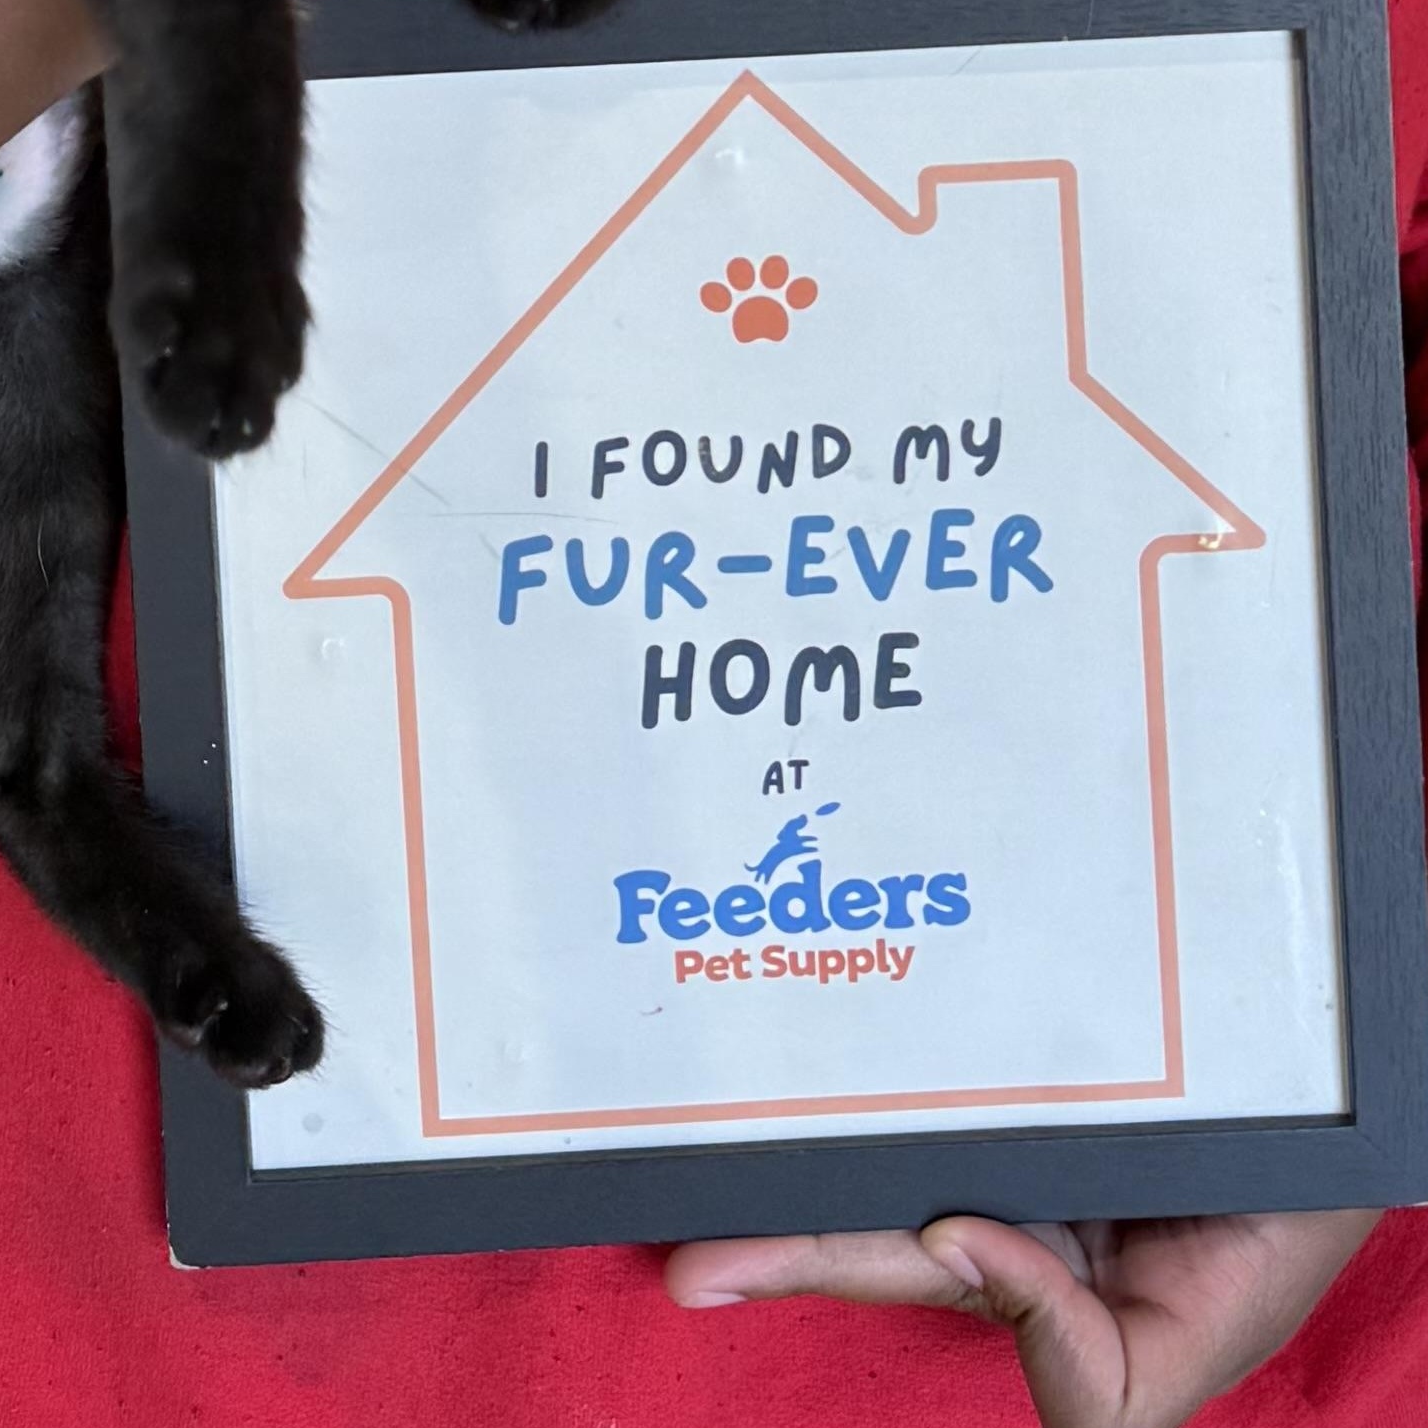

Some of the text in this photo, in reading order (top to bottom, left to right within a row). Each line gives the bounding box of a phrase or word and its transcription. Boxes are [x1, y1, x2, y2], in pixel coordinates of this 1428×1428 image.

[534, 416, 1004, 501] I FOUND MY
[496, 508, 1055, 626] FUR-EVER
[640, 631, 924, 730] HOME
[761, 758, 811, 796] AT
[611, 858, 973, 945] Feeders
[673, 937, 917, 985] Pet Supply
